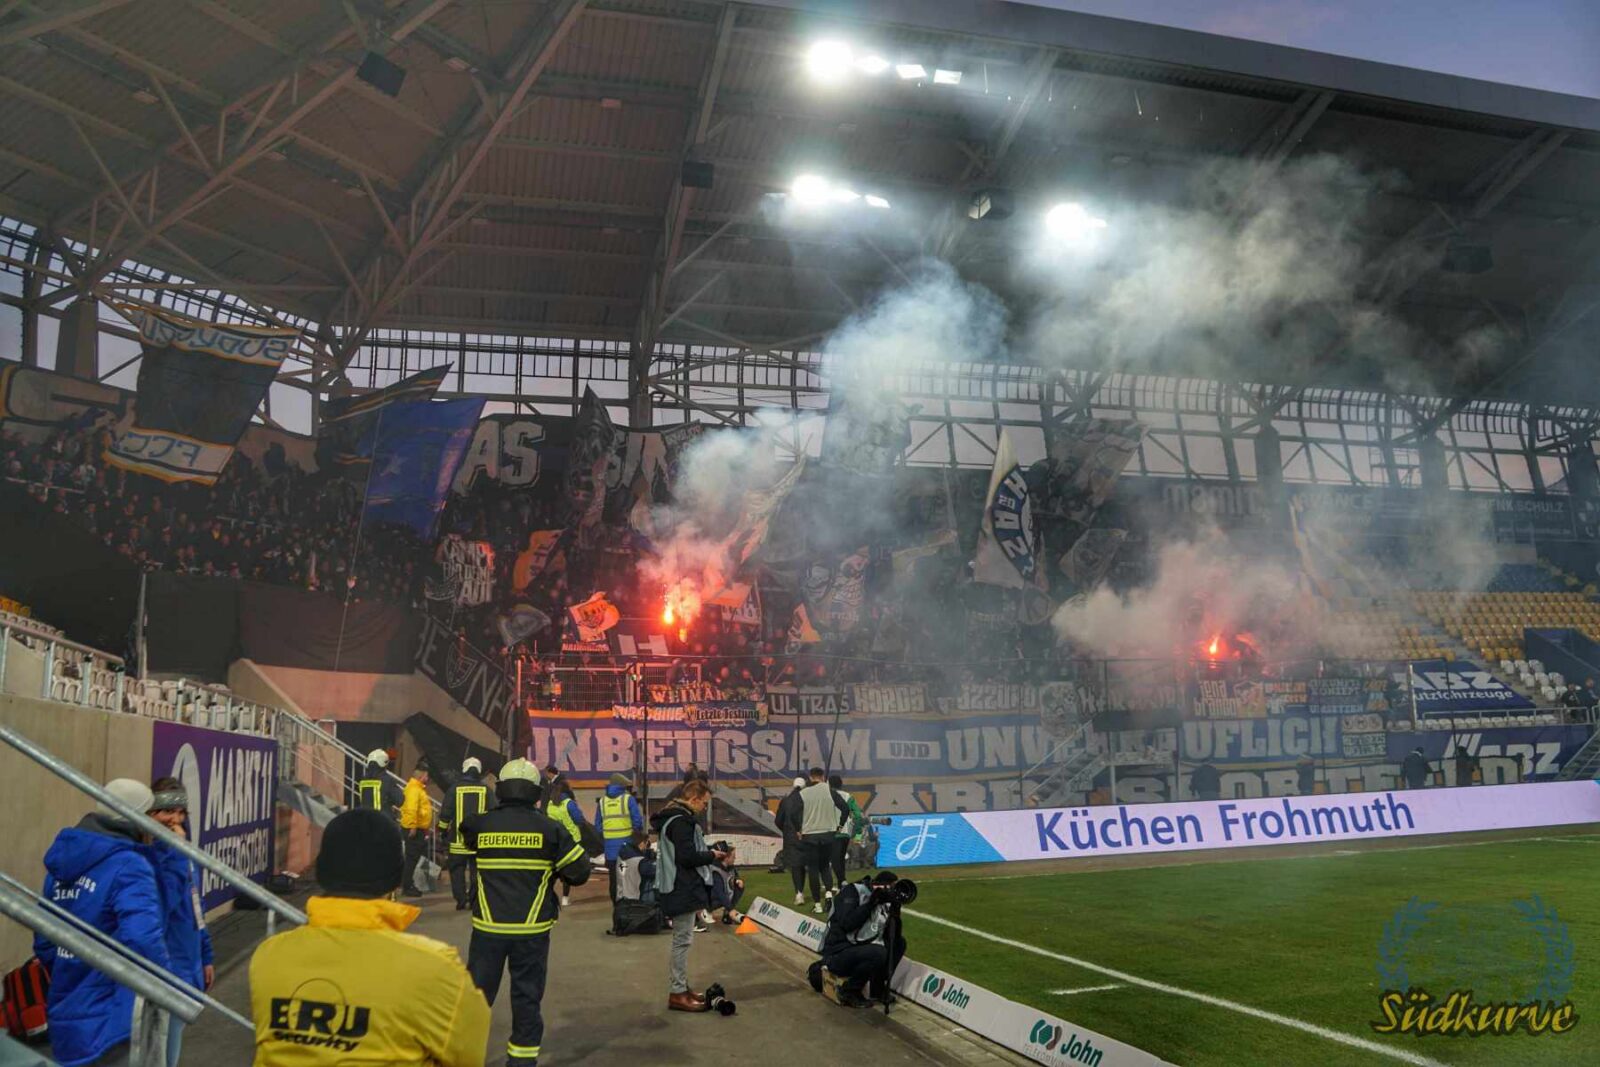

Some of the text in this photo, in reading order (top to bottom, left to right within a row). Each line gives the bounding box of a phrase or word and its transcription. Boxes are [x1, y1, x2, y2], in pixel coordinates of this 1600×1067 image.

[770, 694, 849, 714] ULTRAS
[888, 742, 931, 759] UND
[1035, 806, 1205, 852] Küchen
[1218, 792, 1416, 842] Frohmuth
[478, 834, 542, 847] FEUERWEHR
[941, 983, 971, 1010] John
[269, 997, 371, 1038] ERU
[1059, 1033, 1104, 1067] John
